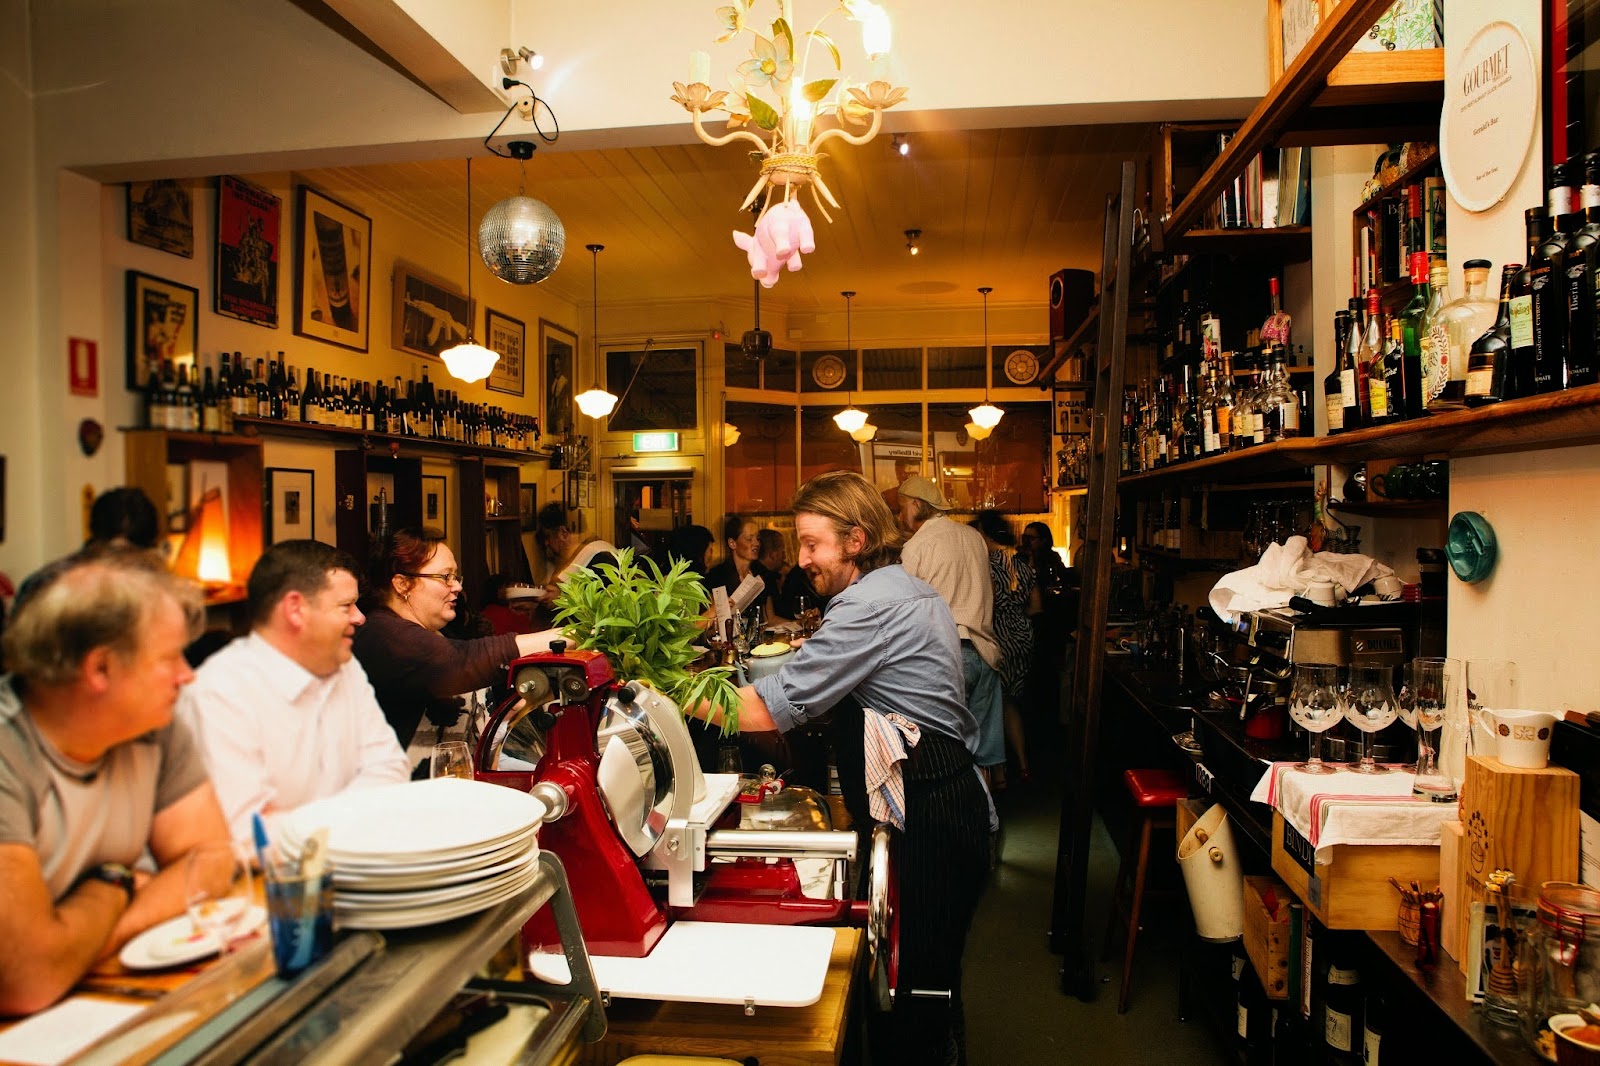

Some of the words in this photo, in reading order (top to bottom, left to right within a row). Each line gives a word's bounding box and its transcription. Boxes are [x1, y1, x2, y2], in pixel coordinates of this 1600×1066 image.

[1463, 42, 1511, 97] GOURMET
[1472, 120, 1490, 136] Gerald's
[1490, 116, 1499, 126] Bar
[1569, 281, 1579, 310] Iberia
[1286, 823, 1312, 867] BINDI
